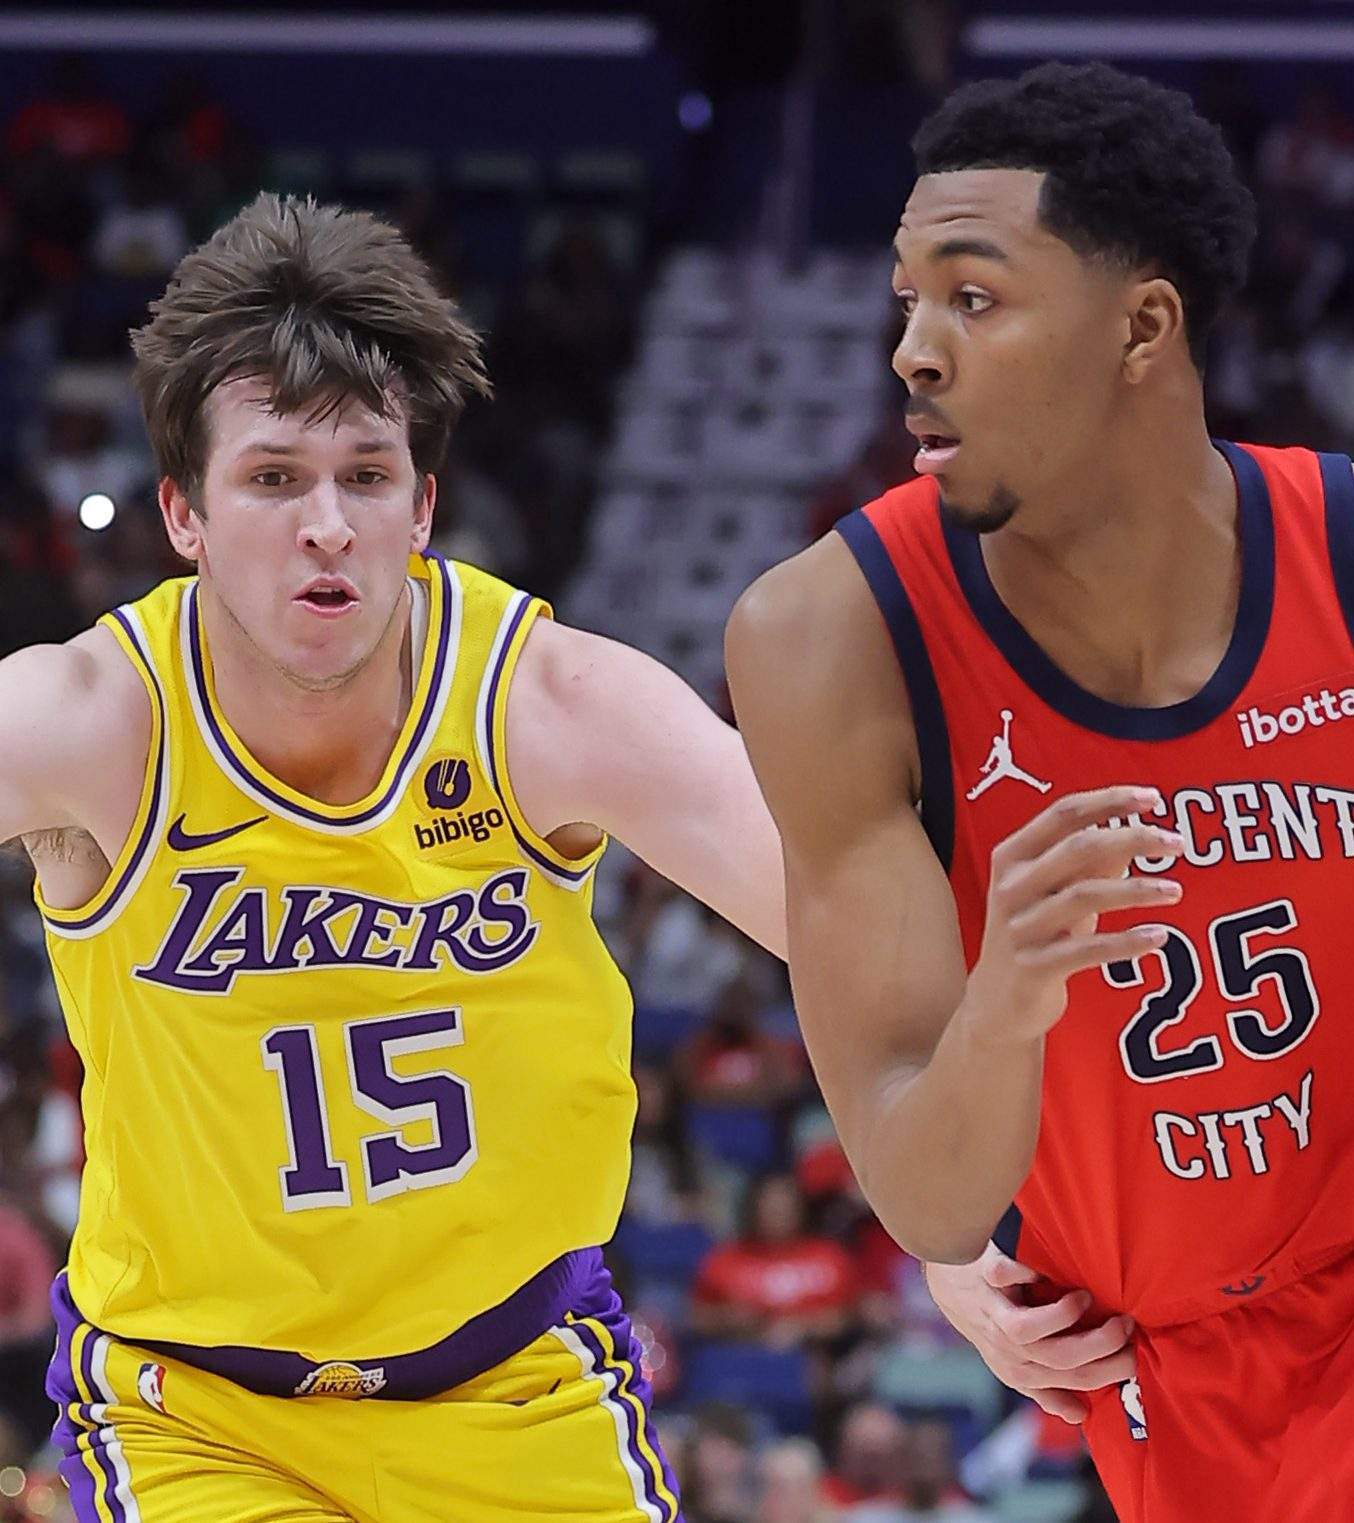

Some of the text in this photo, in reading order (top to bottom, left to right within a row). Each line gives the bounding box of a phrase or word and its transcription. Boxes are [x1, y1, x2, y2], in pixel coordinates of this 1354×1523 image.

[414, 808, 504, 849] bibigo
[132, 866, 541, 995] LAKERS
[1099, 898, 1321, 1084] 25
[260, 1007, 479, 1212] 15
[1153, 1067, 1313, 1179] CITY
[298, 1373, 385, 1396] LAKERS
